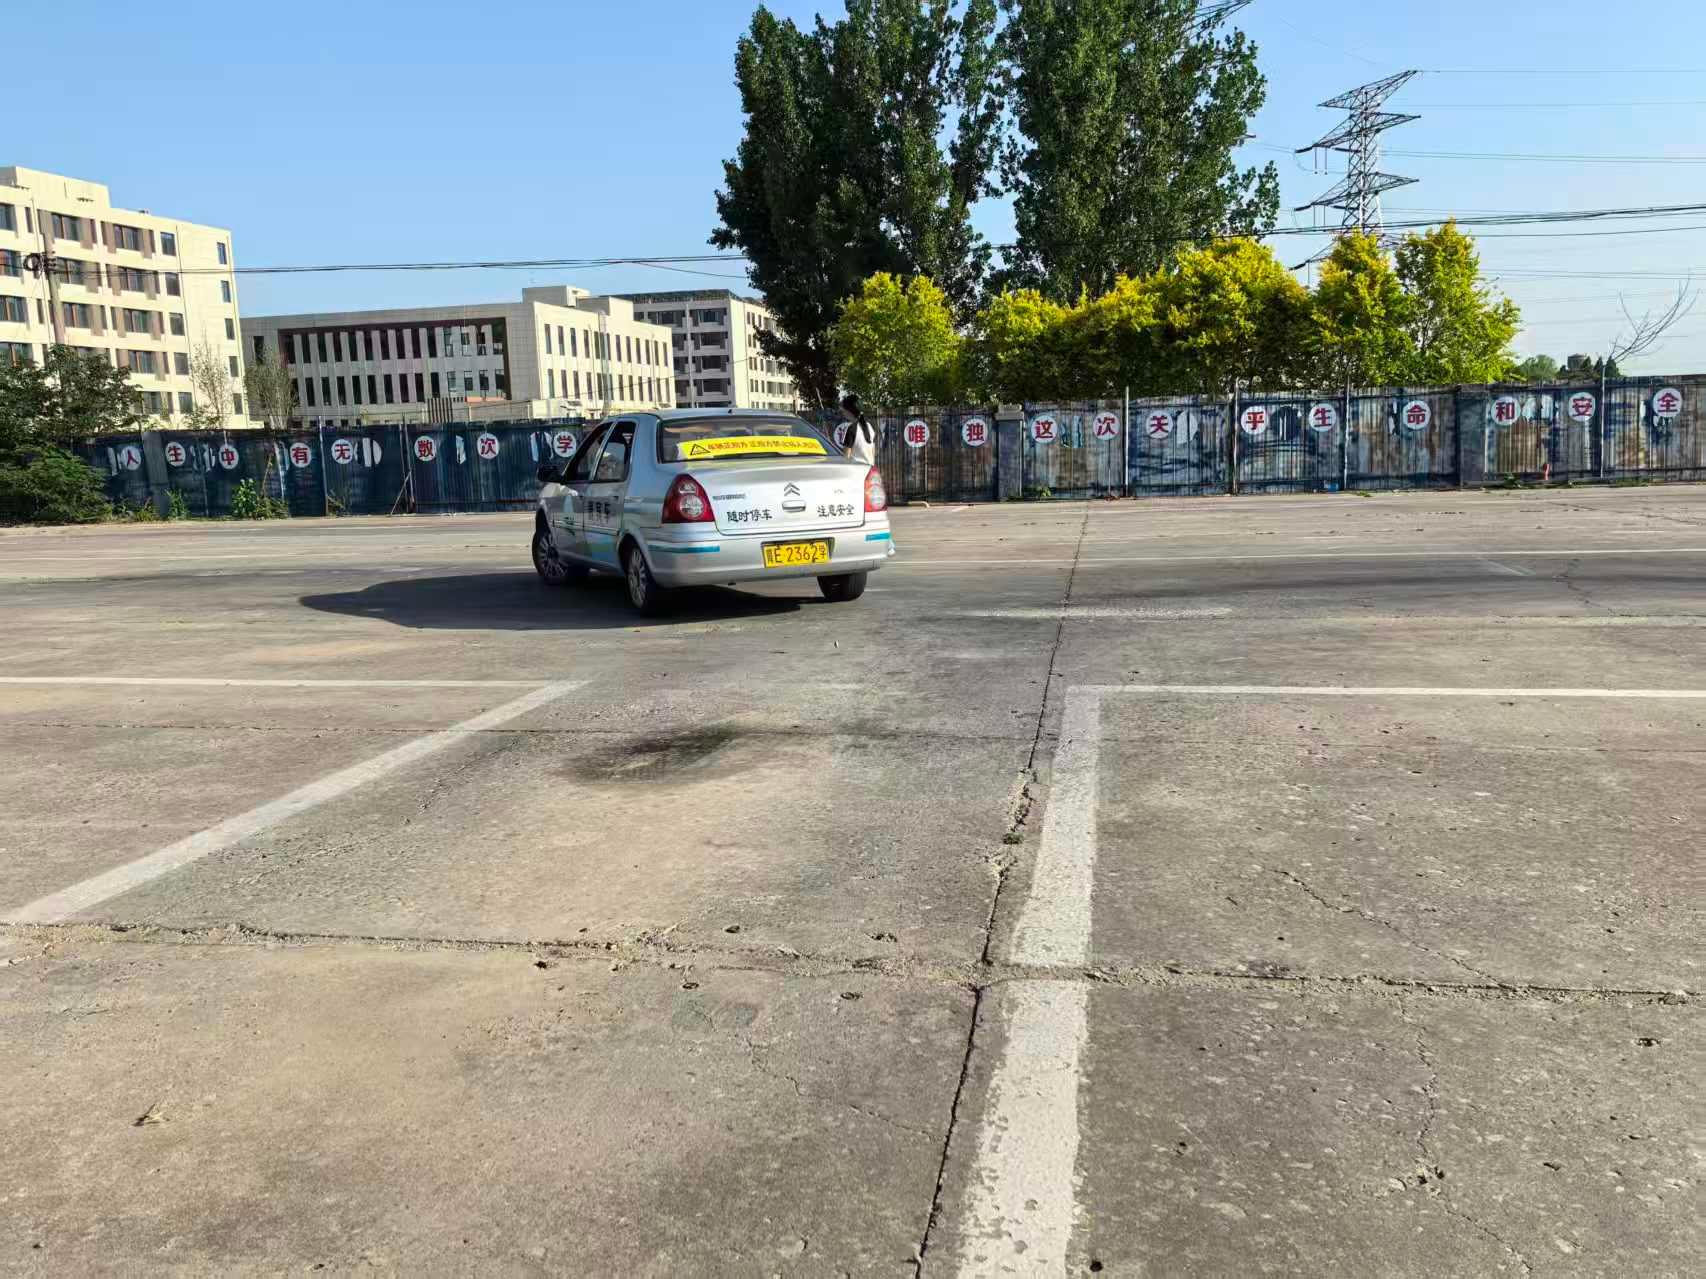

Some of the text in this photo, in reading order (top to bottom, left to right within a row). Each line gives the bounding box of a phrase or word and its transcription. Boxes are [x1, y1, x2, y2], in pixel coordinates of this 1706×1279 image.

[727, 509, 773, 523] 随时停车
[816, 504, 855, 518] 注意安全
